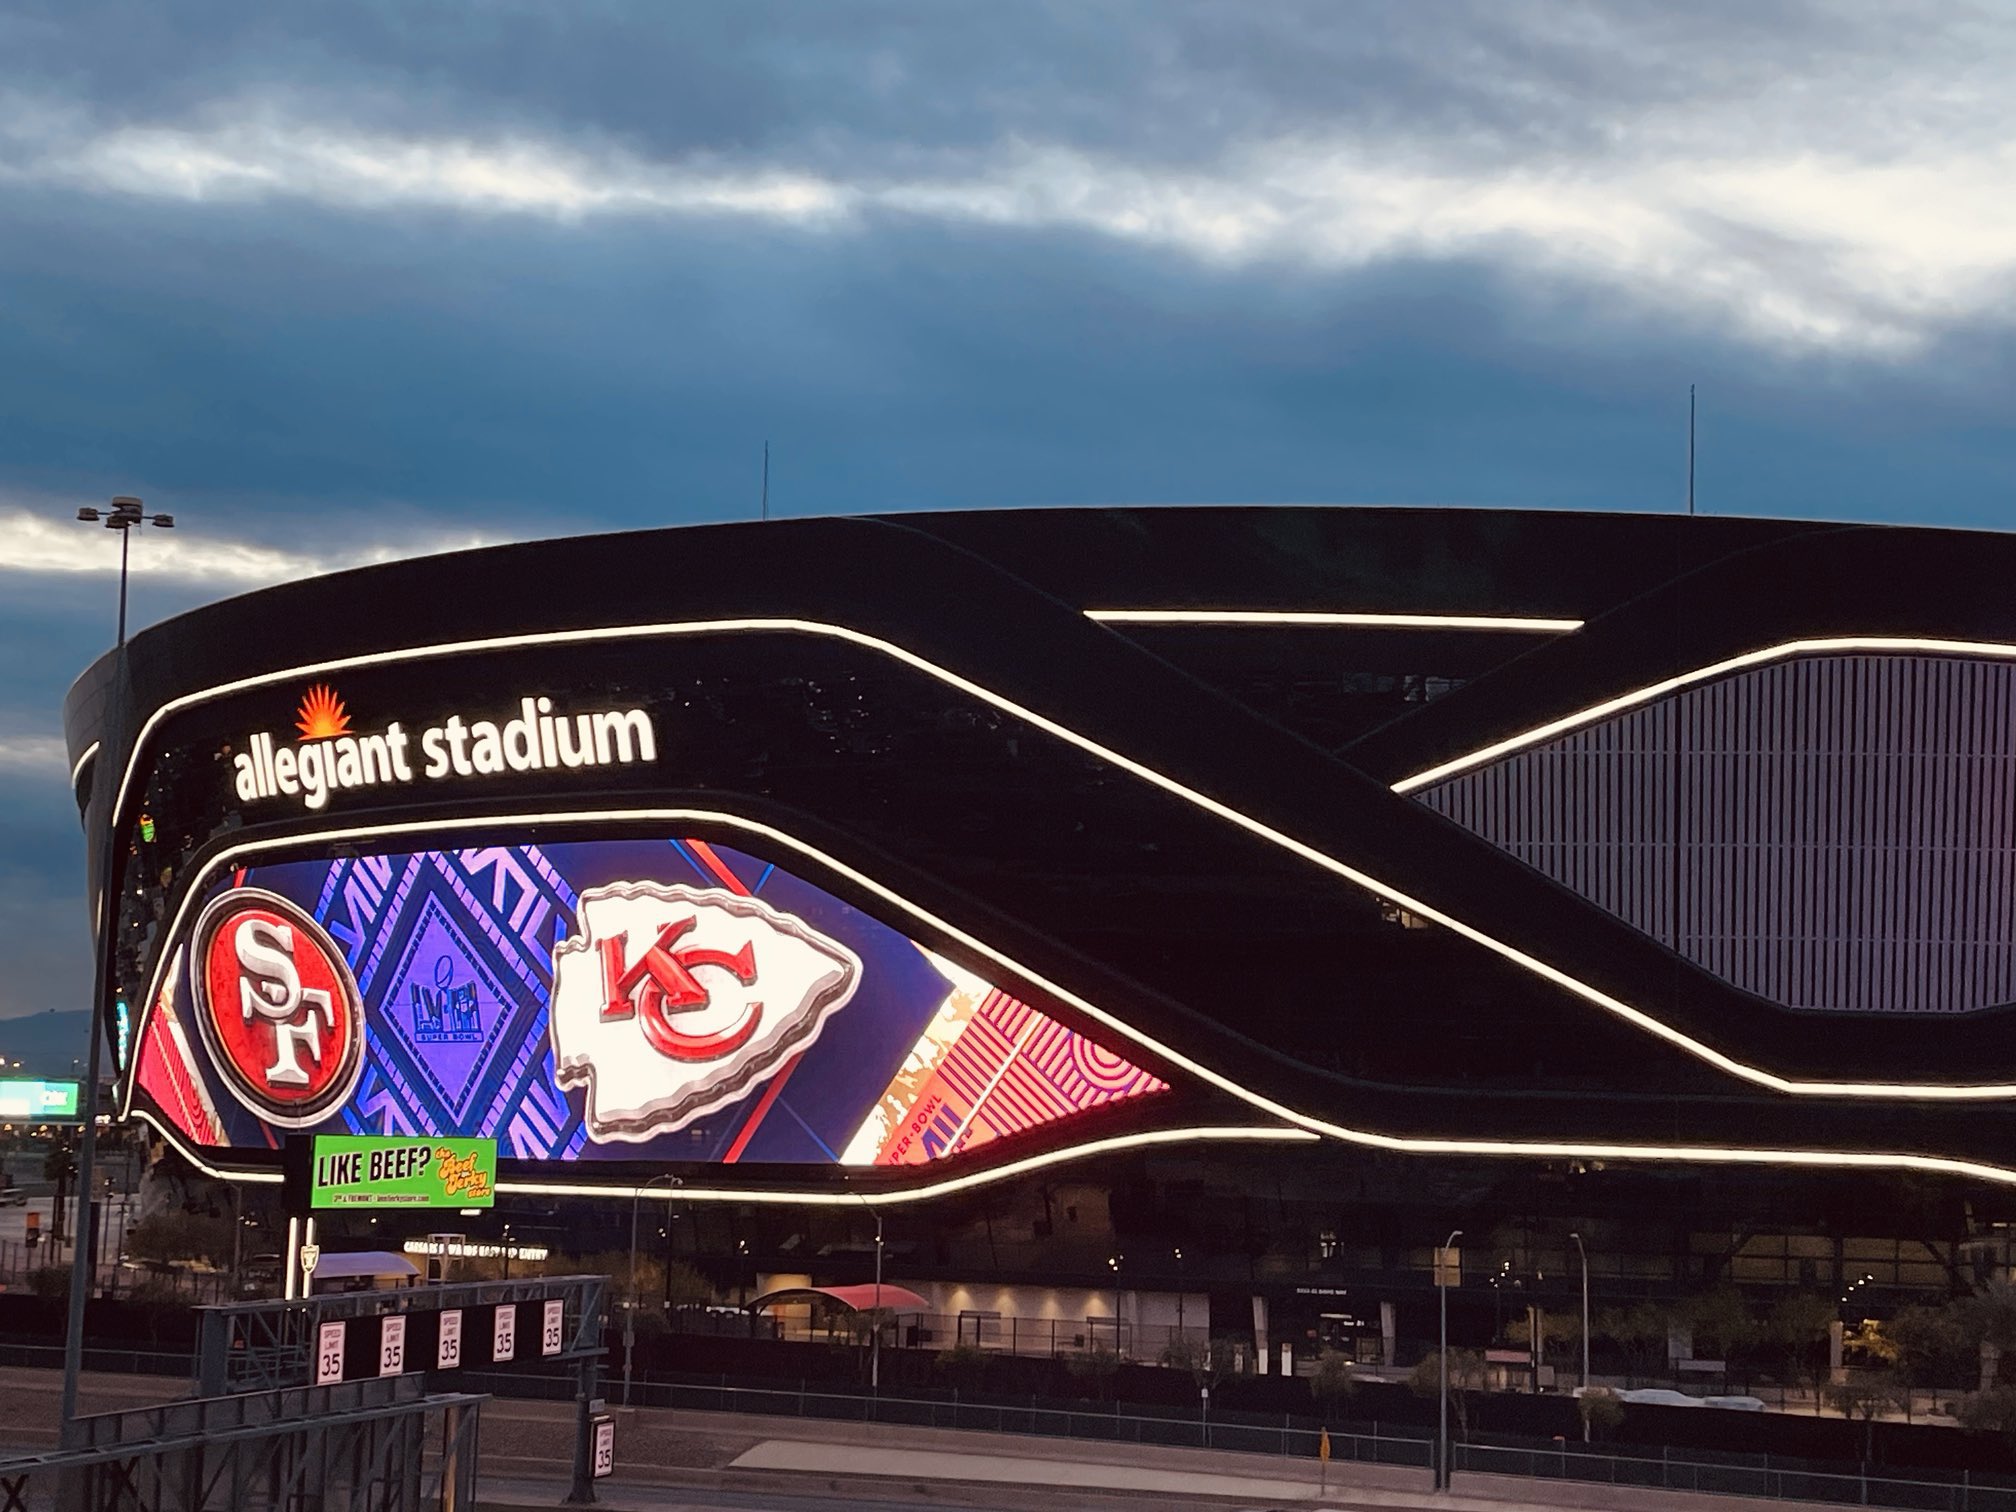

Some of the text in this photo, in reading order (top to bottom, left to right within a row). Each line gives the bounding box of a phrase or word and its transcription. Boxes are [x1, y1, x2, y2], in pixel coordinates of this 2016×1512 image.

[234, 697, 658, 809] allegiant stadium
[595, 914, 764, 1063] KC
[235, 919, 335, 1084] SF
[911, 1095, 942, 1134] BOWL
[317, 1146, 432, 1188] LIKE BEEF?
[439, 1152, 478, 1179] Beef
[446, 1170, 488, 1195] Jerky
[439, 1243, 478, 1257] RWARDS
[324, 1329, 341, 1339] SPEED
[386, 1323, 402, 1332] SPEED
[386, 1334, 400, 1343] LIMIT
[545, 1327, 560, 1347] 35
[441, 1339, 457, 1360] 35
[496, 1333, 512, 1354] 35
[321, 1353, 340, 1376] 35
[384, 1346, 401, 1368] 35
[598, 1449, 611, 1469] 35
